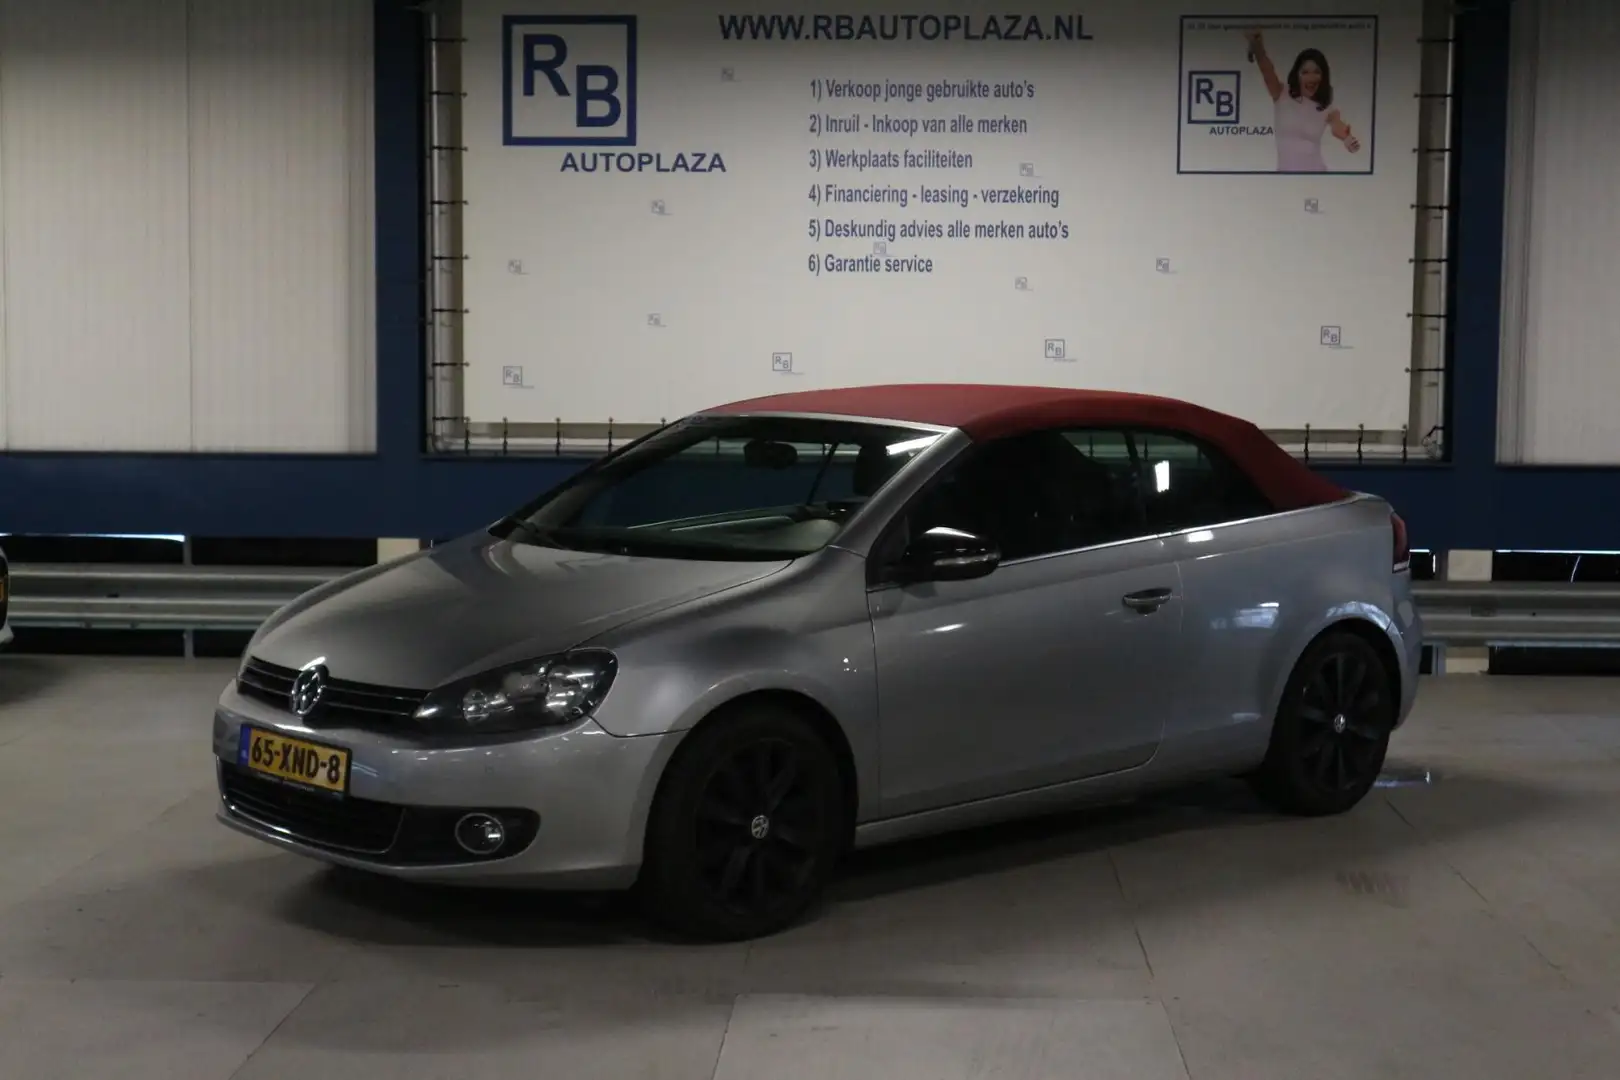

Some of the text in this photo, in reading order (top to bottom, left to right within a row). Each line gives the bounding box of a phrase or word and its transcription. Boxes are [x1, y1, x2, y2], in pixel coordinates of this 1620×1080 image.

[718, 14, 1093, 41] WWW.RBAUTOPLAZA.NL
[810, 79, 1035, 102] 1) Verkoop jonge gebruikte auto's
[809, 114, 821, 136] 2)
[825, 114, 860, 133] Inruil
[872, 114, 918, 137] Inkoop
[922, 119, 946, 133] van
[950, 115, 974, 133] alle
[977, 115, 1028, 133] merken
[1209, 126, 1274, 136] AUTOPLAZA
[560, 152, 727, 173] AUTOPLAZA
[809, 149, 973, 172] 3) Werkplaats faciliteiten
[808, 184, 821, 207] 4)
[825, 184, 908, 207] Financiering
[920, 185, 969, 207] leasing
[981, 185, 1060, 208] verzekering
[808, 219, 1070, 242] 5) Deskundig advies alle merken auto's
[808, 254, 933, 276] 6) Garantie service
[251, 736, 341, 784] 65-XND-8
